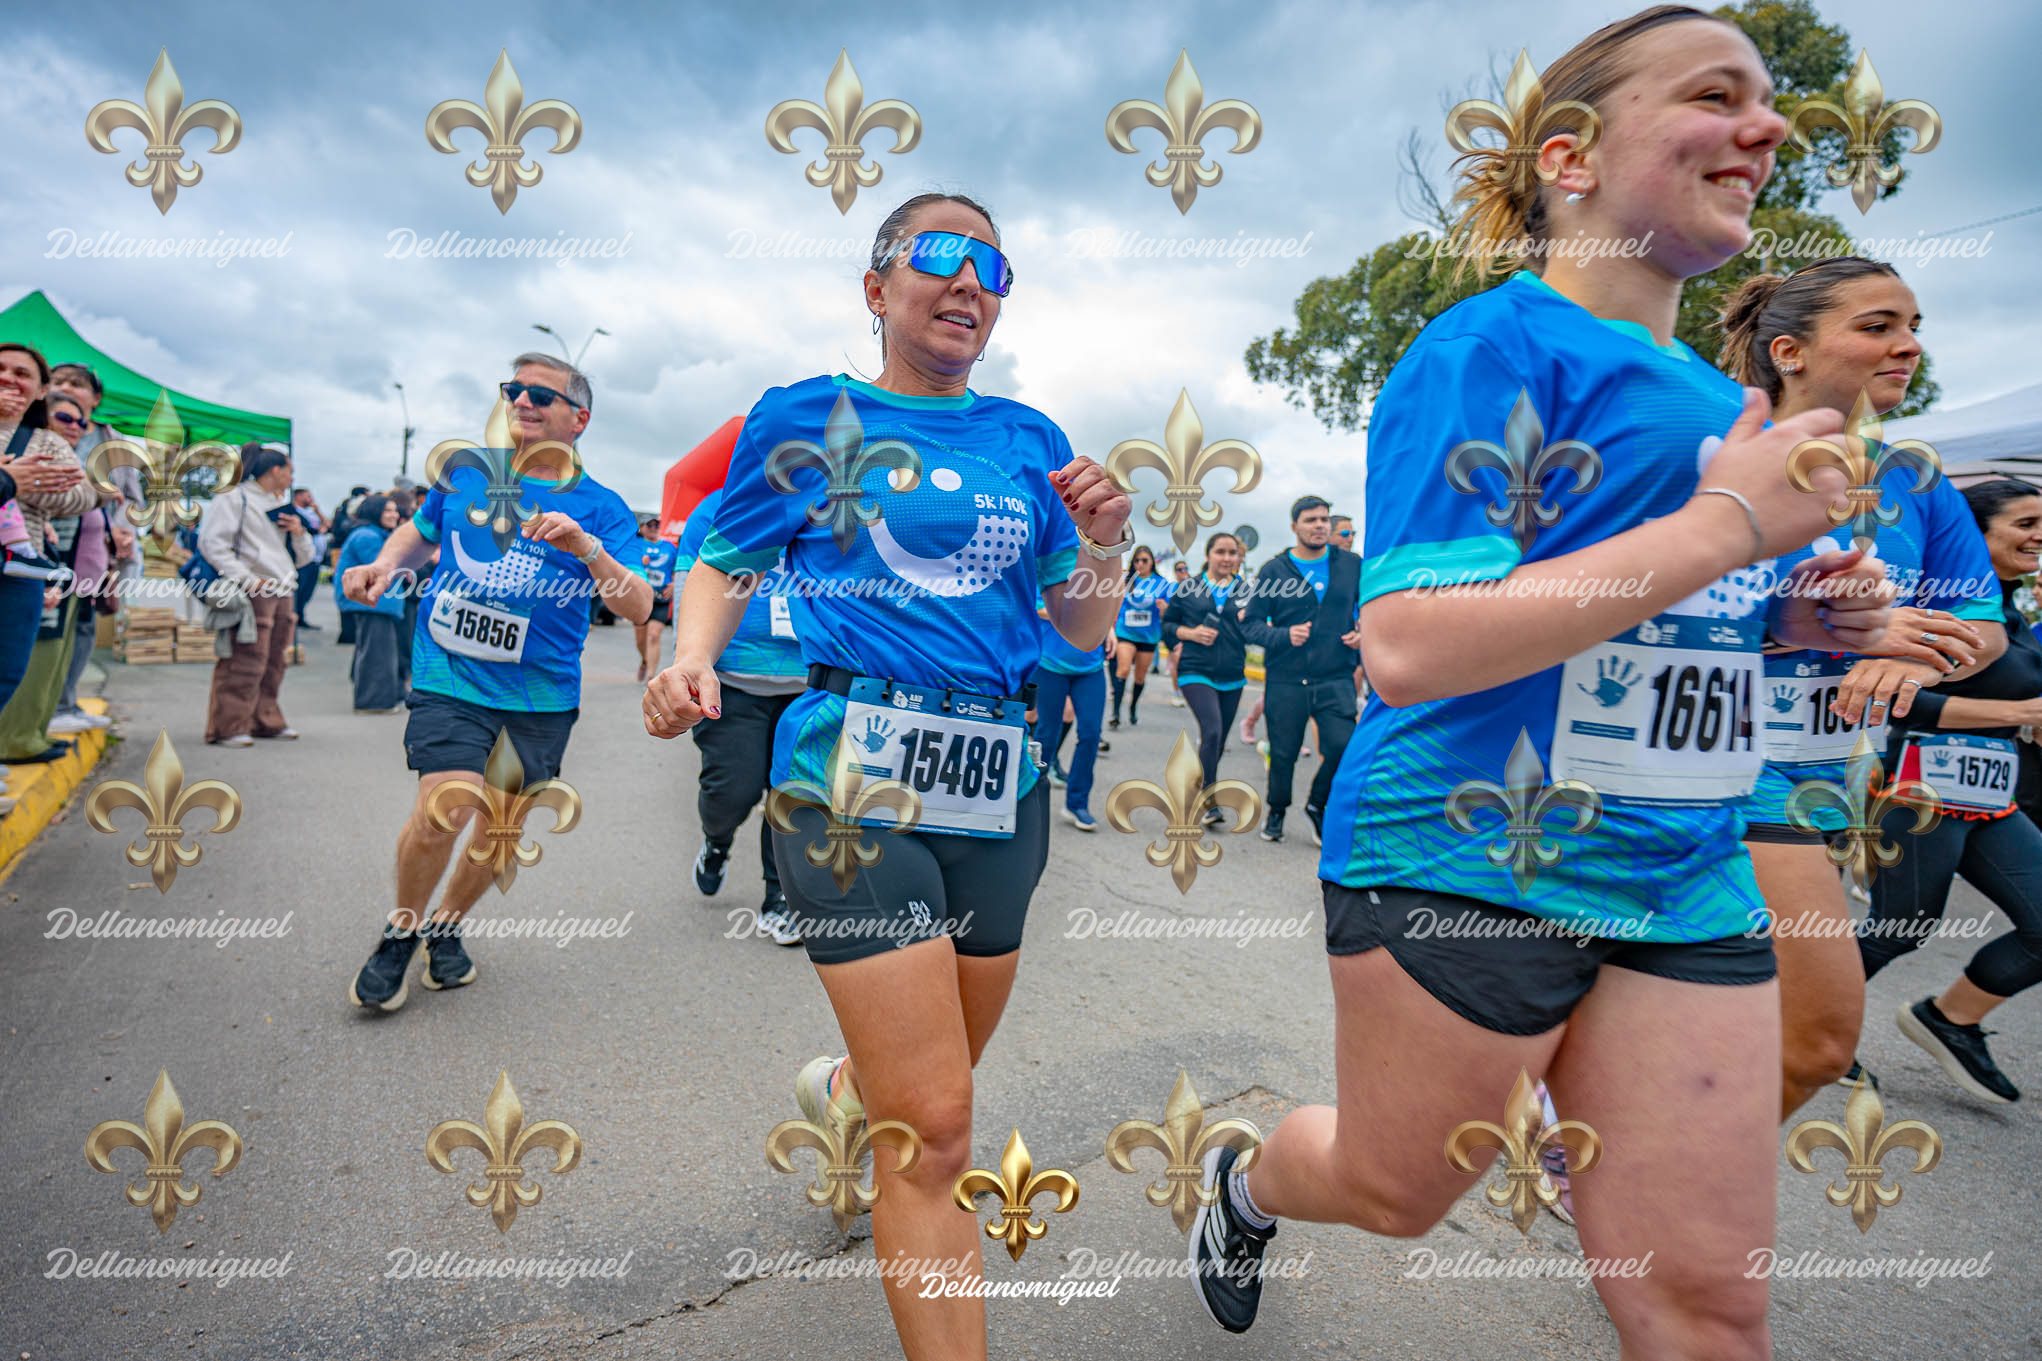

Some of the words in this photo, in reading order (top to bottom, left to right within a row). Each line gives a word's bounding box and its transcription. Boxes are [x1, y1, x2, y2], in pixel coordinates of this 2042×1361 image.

[454, 608, 520, 650] 15856
[899, 728, 1008, 801] 15489
[1957, 755, 2010, 792] 15729
